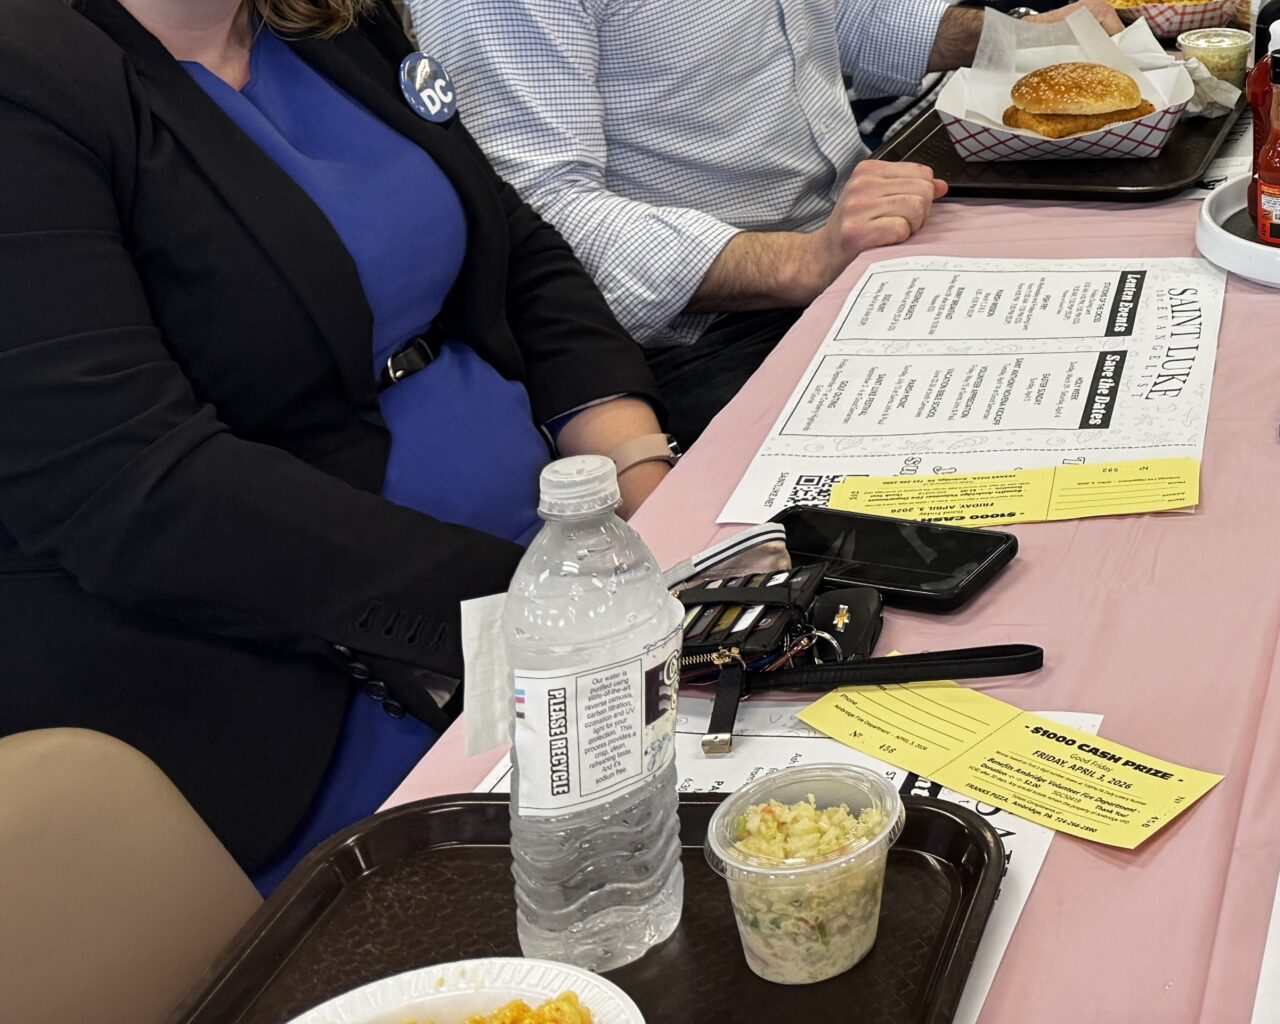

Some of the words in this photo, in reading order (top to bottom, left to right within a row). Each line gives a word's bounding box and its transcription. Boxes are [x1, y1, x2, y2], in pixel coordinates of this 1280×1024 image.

[1121, 273, 1141, 300] Lenten
[1112, 301, 1134, 332] Events
[1168, 288, 1202, 339] SAINT
[1100, 354, 1121, 377] Save
[1132, 306, 1168, 397] EVANGELIST
[1095, 377, 1116, 395] the
[1145, 345, 1199, 400] LUKE
[1087, 395, 1111, 425] Dates
[970, 512, 1017, 520] $1000
[548, 687, 567, 737] PLEASE
[840, 693, 857, 705] Phone
[549, 737, 570, 796] RECYCLE
[1030, 726, 1076, 745] $1000
[1077, 743, 1122, 763] CASH
[1121, 759, 1173, 779] PRIZE
[1032, 750, 1068, 767] FRIDAY,
[1067, 764, 1095, 777] APRIL
[1107, 777, 1132, 789] 2026
[1069, 753, 1091, 764] Good
[1090, 760, 1113, 772] Friday
[965, 782, 990, 794] FRANKS
[1011, 801, 1041, 815] Ambridge,
[980, 763, 1007, 775] Donation
[1023, 779, 1040, 788] $2.00
[1095, 804, 1113, 813] Thank
[987, 757, 1013, 770] Benefits
[1013, 768, 1047, 782] Ambridge
[1047, 780, 1080, 794] Volunteer
[1094, 796, 1136, 812] Department
